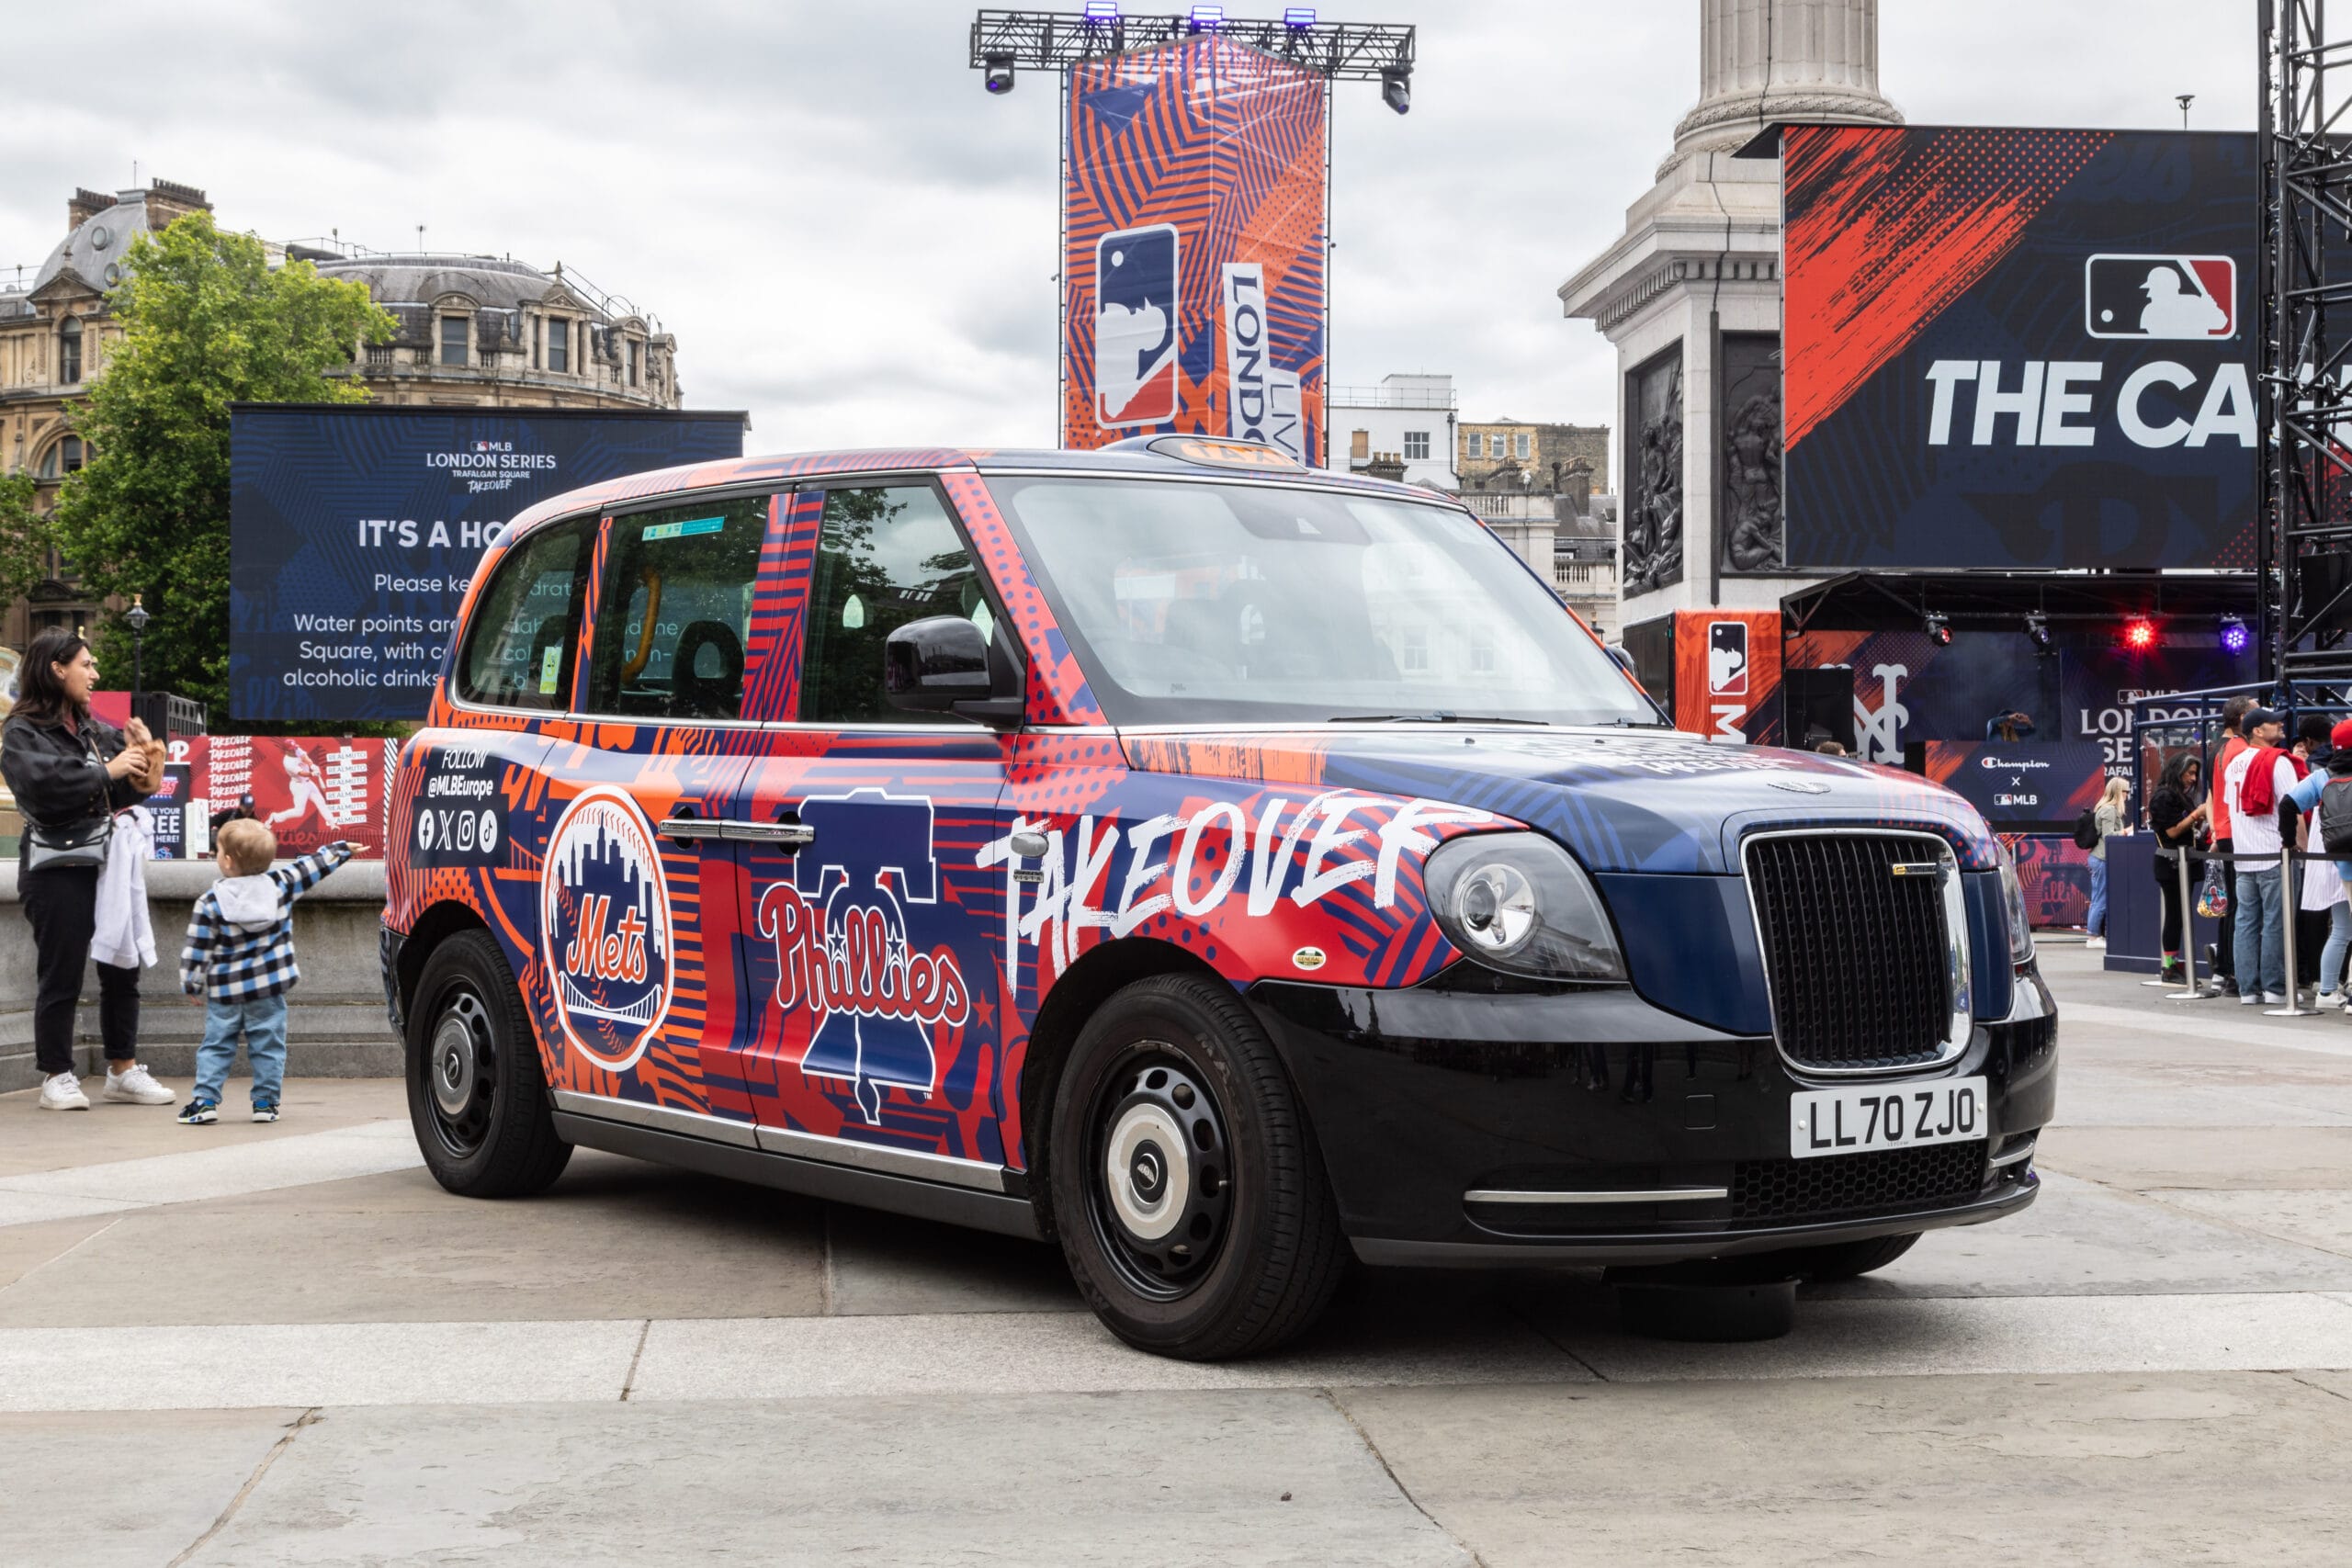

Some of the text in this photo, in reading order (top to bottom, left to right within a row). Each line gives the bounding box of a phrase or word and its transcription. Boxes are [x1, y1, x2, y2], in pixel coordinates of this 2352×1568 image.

[1232, 274, 1266, 443] LOND
[1925, 359, 2103, 446] THE
[1270, 383, 1299, 463] LIV
[489, 442, 513, 452] MLB
[426, 453, 556, 468] LONDON SERIES
[452, 469, 497, 479] TRAFALGAR
[467, 479, 513, 494] TAKEOVER
[359, 519, 506, 549] IT'S A HO
[375, 573, 442, 592] Please
[448, 575, 471, 592] ke
[294, 614, 356, 633] Water
[361, 615, 424, 636] points
[300, 641, 378, 662] Square,
[383, 643, 425, 660] with
[283, 669, 377, 687] alcoholic
[442, 749, 490, 769] FOLLOW
[1981, 756, 2050, 772] Champion
[428, 774, 493, 801] @MLBEurope
[209, 797, 240, 810] TAKEO
[2013, 795, 2038, 805] MLB
[155, 835, 180, 843] HERE!
[976, 789, 1494, 1001] TAKEOVER
[566, 893, 648, 985] Mets
[758, 882, 970, 1028] Phillies
[1810, 1095, 1905, 1149] LL70
